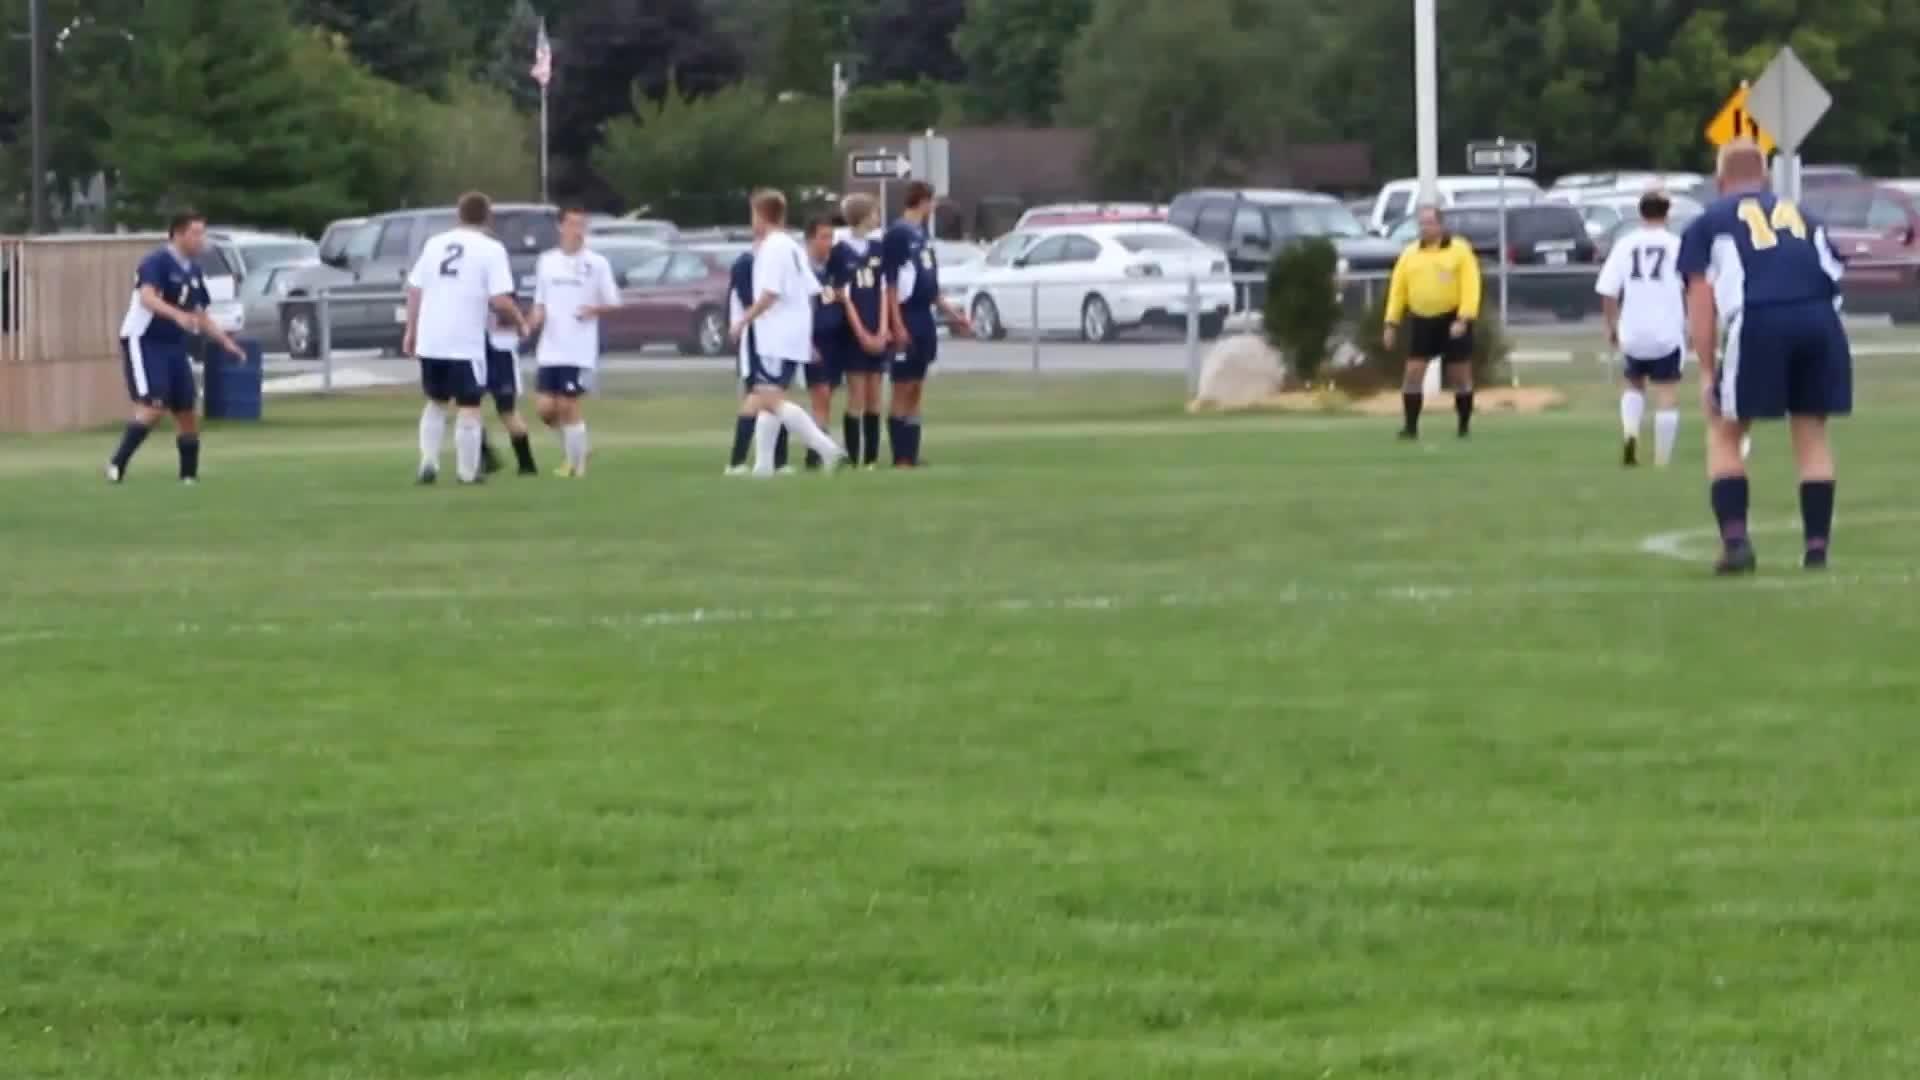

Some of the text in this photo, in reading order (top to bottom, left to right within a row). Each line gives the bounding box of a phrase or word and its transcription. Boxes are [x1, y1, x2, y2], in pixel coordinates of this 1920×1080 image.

[1737, 197, 1806, 250] 14
[439, 243, 464, 277] 2
[1630, 246, 1666, 279] 17
